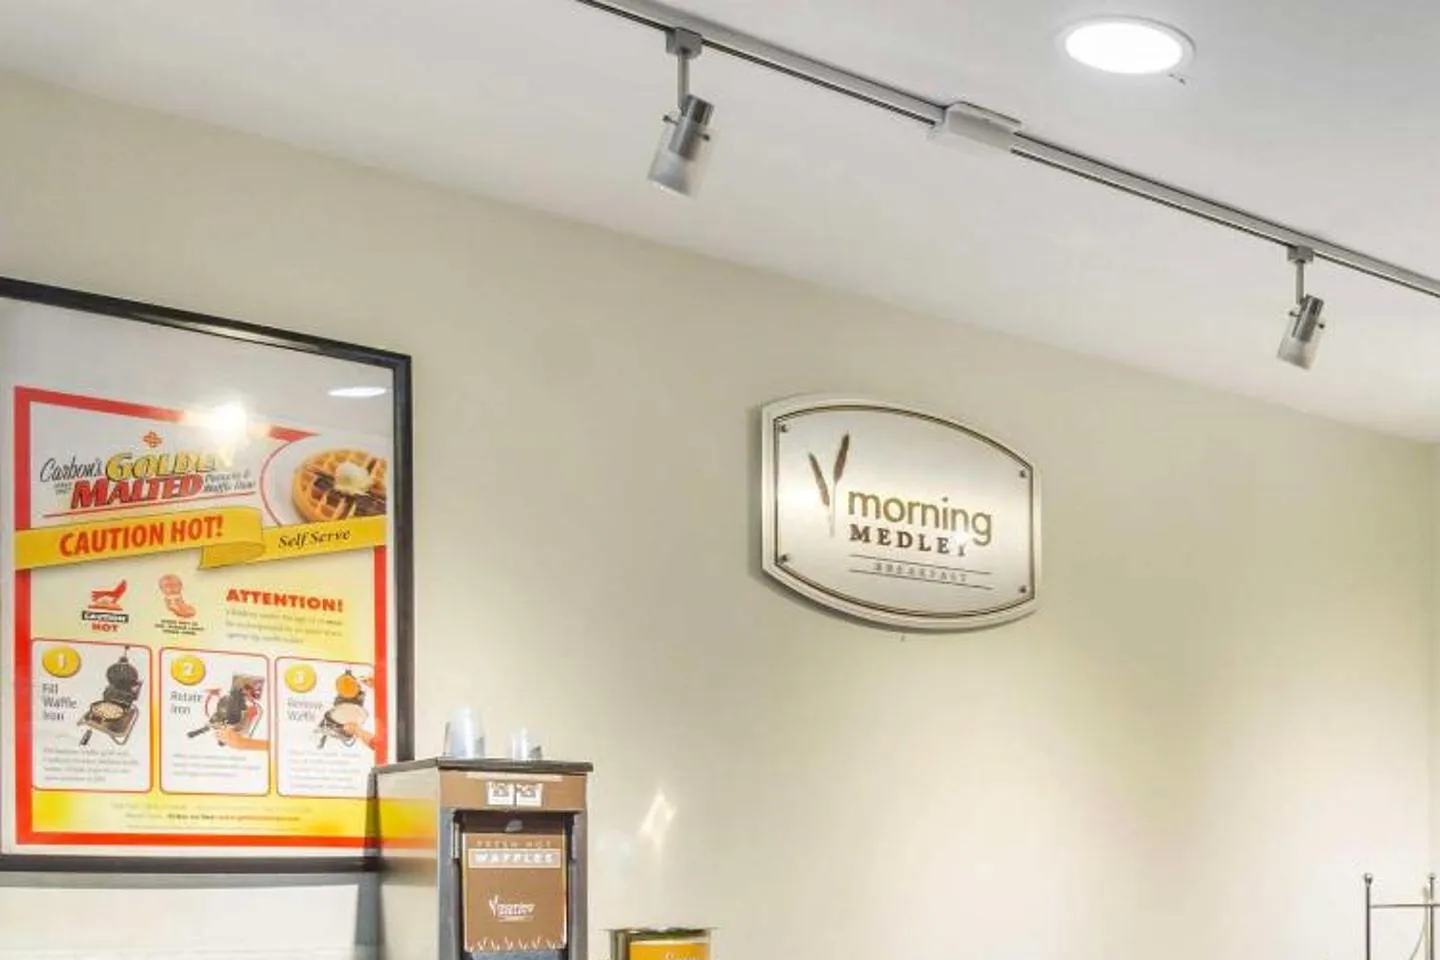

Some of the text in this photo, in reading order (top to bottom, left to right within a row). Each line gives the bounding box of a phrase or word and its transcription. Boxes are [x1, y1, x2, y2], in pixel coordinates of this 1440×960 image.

[70, 472, 204, 509] MALTED
[848, 490, 992, 546] morning
[59, 515, 223, 558] CAUTION HOT!
[278, 529, 350, 549] Self Serve
[226, 588, 343, 613] ATTENTION!
[475, 852, 553, 864] WAFFLES
